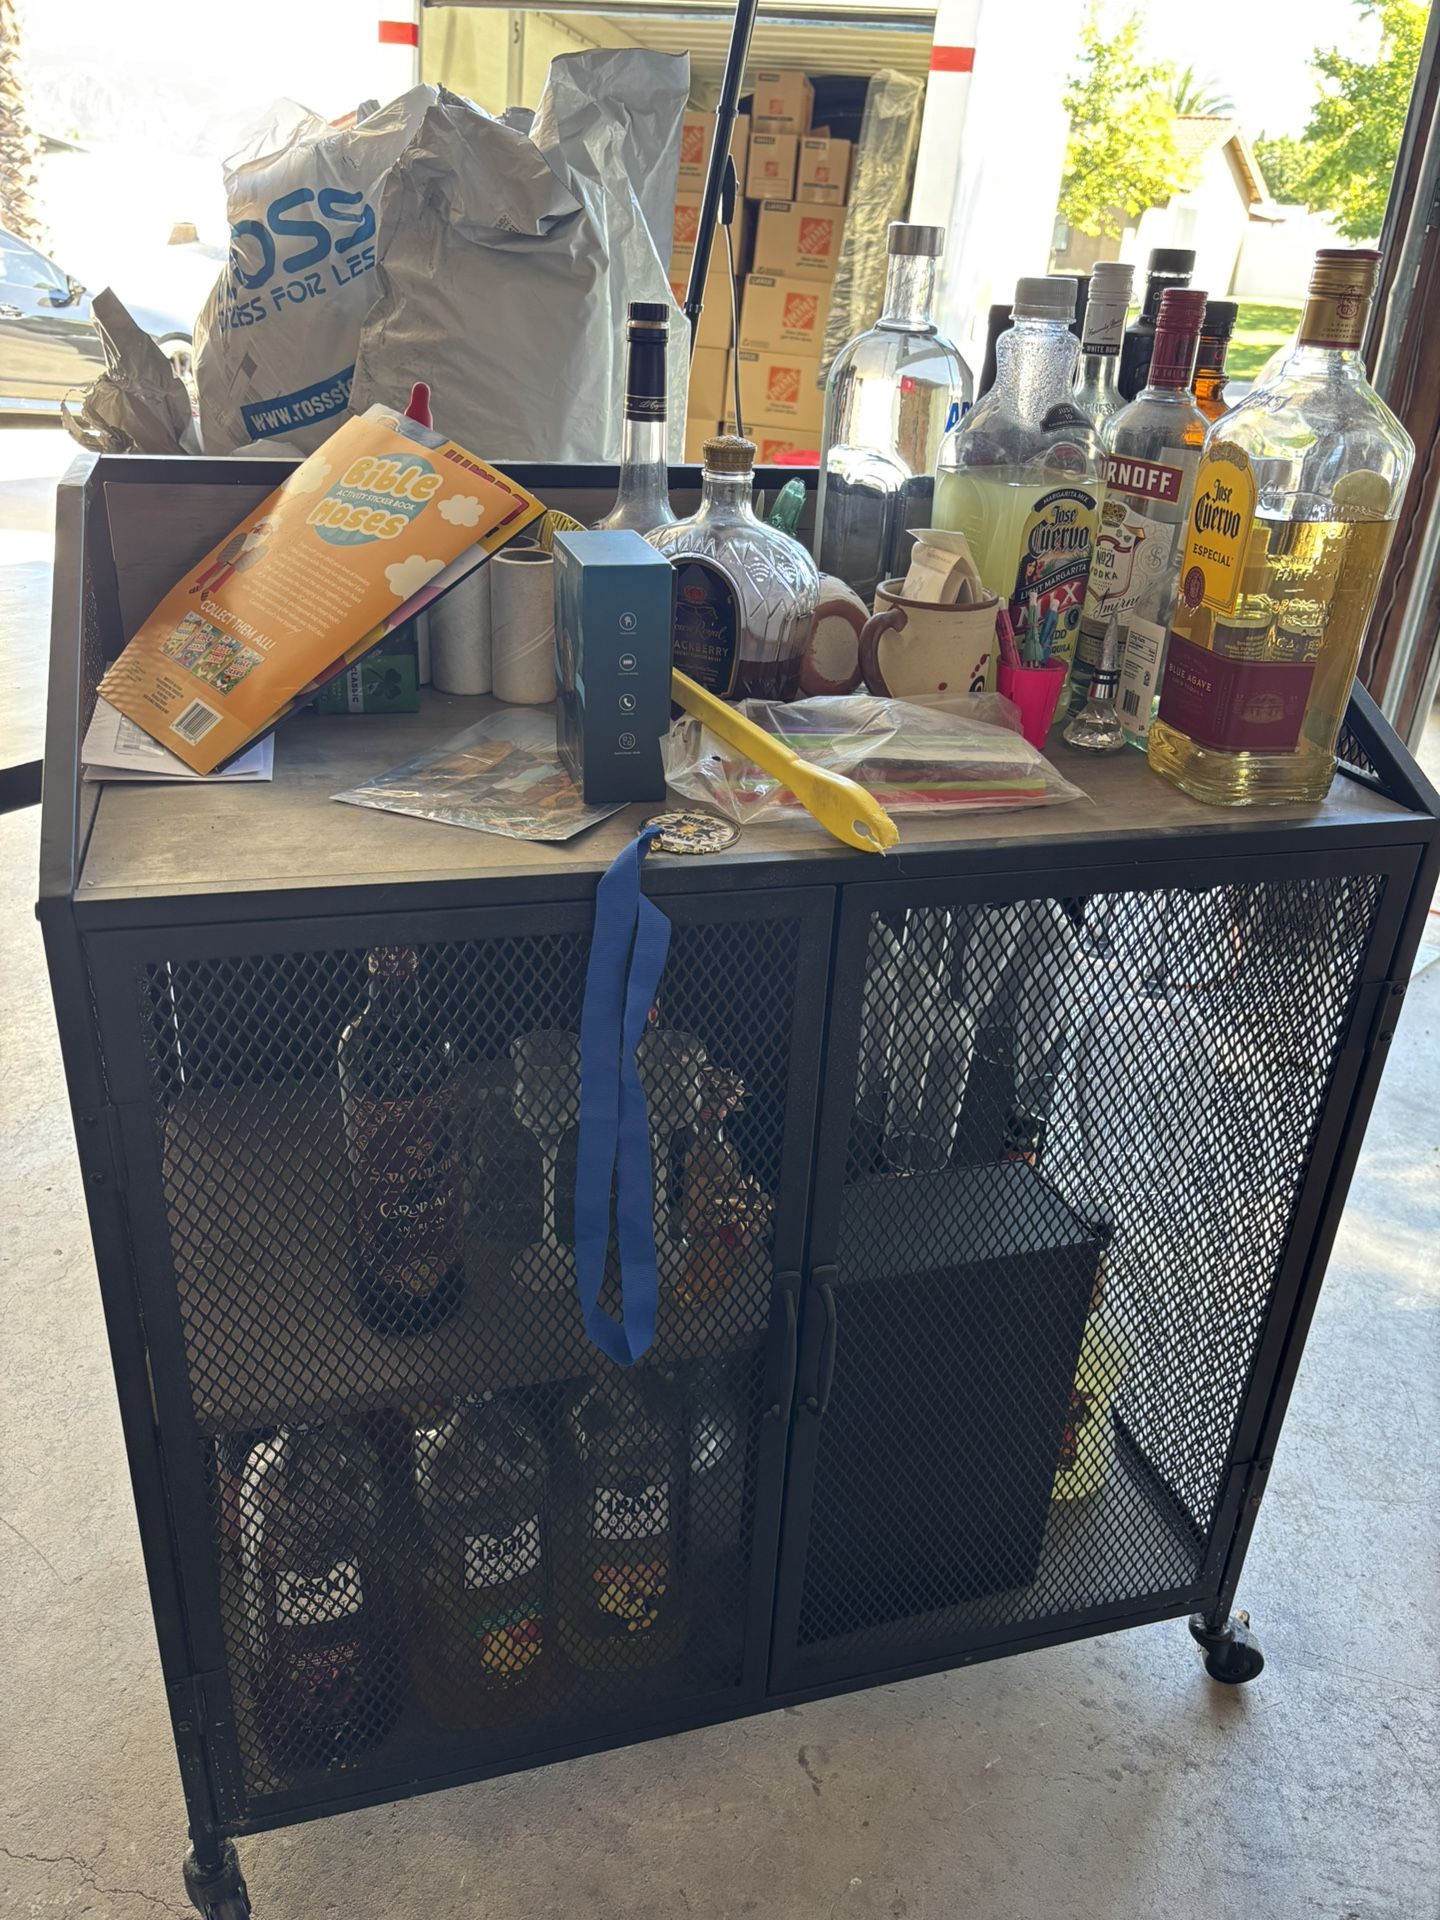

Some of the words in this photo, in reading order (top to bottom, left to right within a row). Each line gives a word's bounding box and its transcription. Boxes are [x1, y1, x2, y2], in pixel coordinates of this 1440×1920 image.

[270, 272, 326, 311] FOR
[331, 245, 376, 286] LES
[1086, 345, 1104, 353] WHITE
[342, 457, 441, 501] Bible
[1211, 478, 1233, 504] Jose
[336, 489, 368, 501] ACTIVITY
[367, 495, 394, 506] STICKER
[392, 499, 416, 511] BOOK
[1043, 490, 1078, 505] MARGARITA
[1077, 492, 1090, 503] MIX
[308, 499, 408, 538] Moses
[1052, 505, 1077, 527] Jose
[1194, 491, 1241, 540] Cuervo
[1027, 519, 1091, 559] Cuervo
[1192, 543, 1232, 567] ESPECIAL
[1044, 563, 1087, 588] MARGARITA
[200, 600, 235, 625] COLLECT
[231, 618, 258, 639] THEM
[254, 634, 277, 651] ALL!
[1053, 629, 1067, 640] DD
[1168, 663, 1186, 680] BLUE
[1186, 676, 1213, 692] AGAVE
